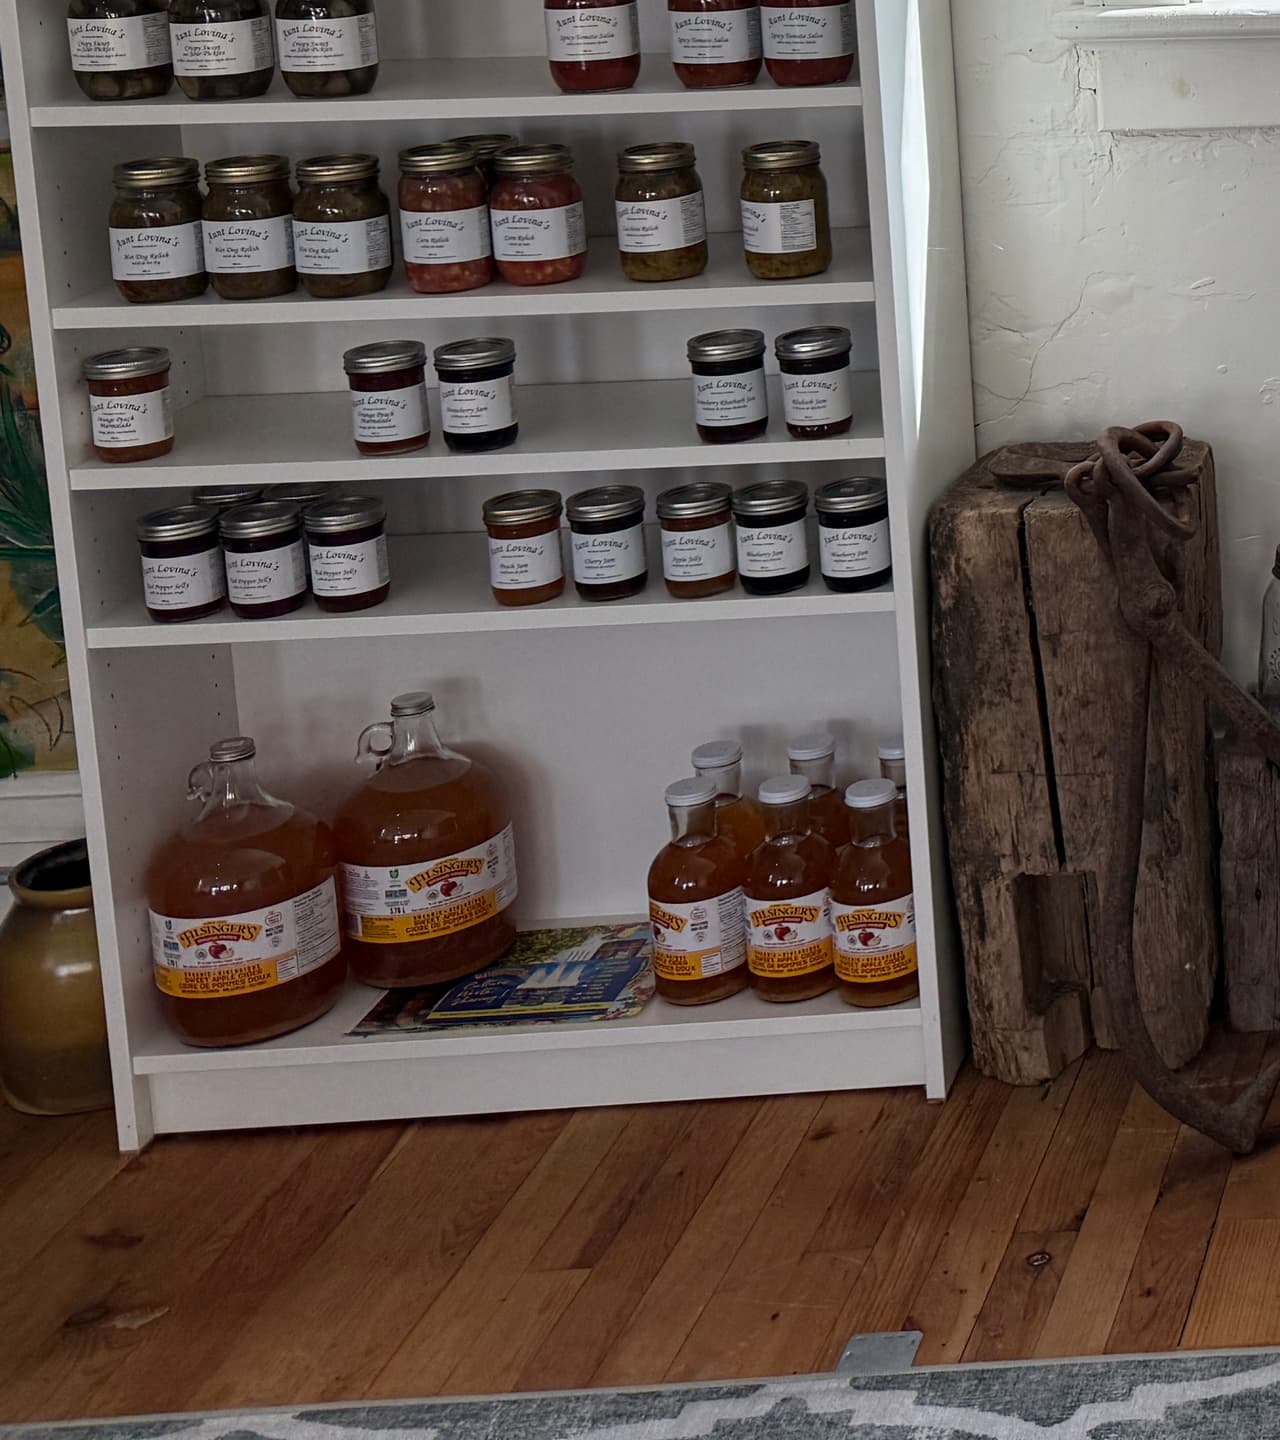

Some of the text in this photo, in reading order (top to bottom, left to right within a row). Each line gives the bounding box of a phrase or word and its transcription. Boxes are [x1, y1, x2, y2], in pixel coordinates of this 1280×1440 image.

[694, 16, 734, 32] Lovina's
[788, 11, 828, 28] Lovina's
[84, 23, 126, 39] Lovina's
[194, 27, 236, 43] Lovina's
[302, 23, 344, 39] Lovina's
[630, 205, 669, 221] Lovina's
[424, 216, 465, 232] Lovina's
[511, 214, 551, 230] Lovina's
[137, 232, 181, 248] Lovina's
[228, 226, 270, 241] Lovina's
[310, 226, 349, 243] Lovina's
[716, 380, 753, 392] Lovina's
[801, 379, 838, 392] Lovina's
[457, 387, 497, 400] Lovina's
[106, 400, 148, 414] Lovina's
[367, 396, 408, 410] Lovina's
[679, 536, 717, 549] Lovina's
[756, 531, 794, 544] Lovina's
[841, 531, 878, 543] Lovina's
[505, 543, 545, 556] Lovina's
[591, 539, 630, 551] Lovina's
[325, 550, 366, 563] Lovina's
[156, 563, 199, 578] Lovina's
[240, 559, 281, 571] Lovina's
[754, 907, 818, 928] FILSINGER'S
[180, 922, 258, 946] FILSINGER'S
